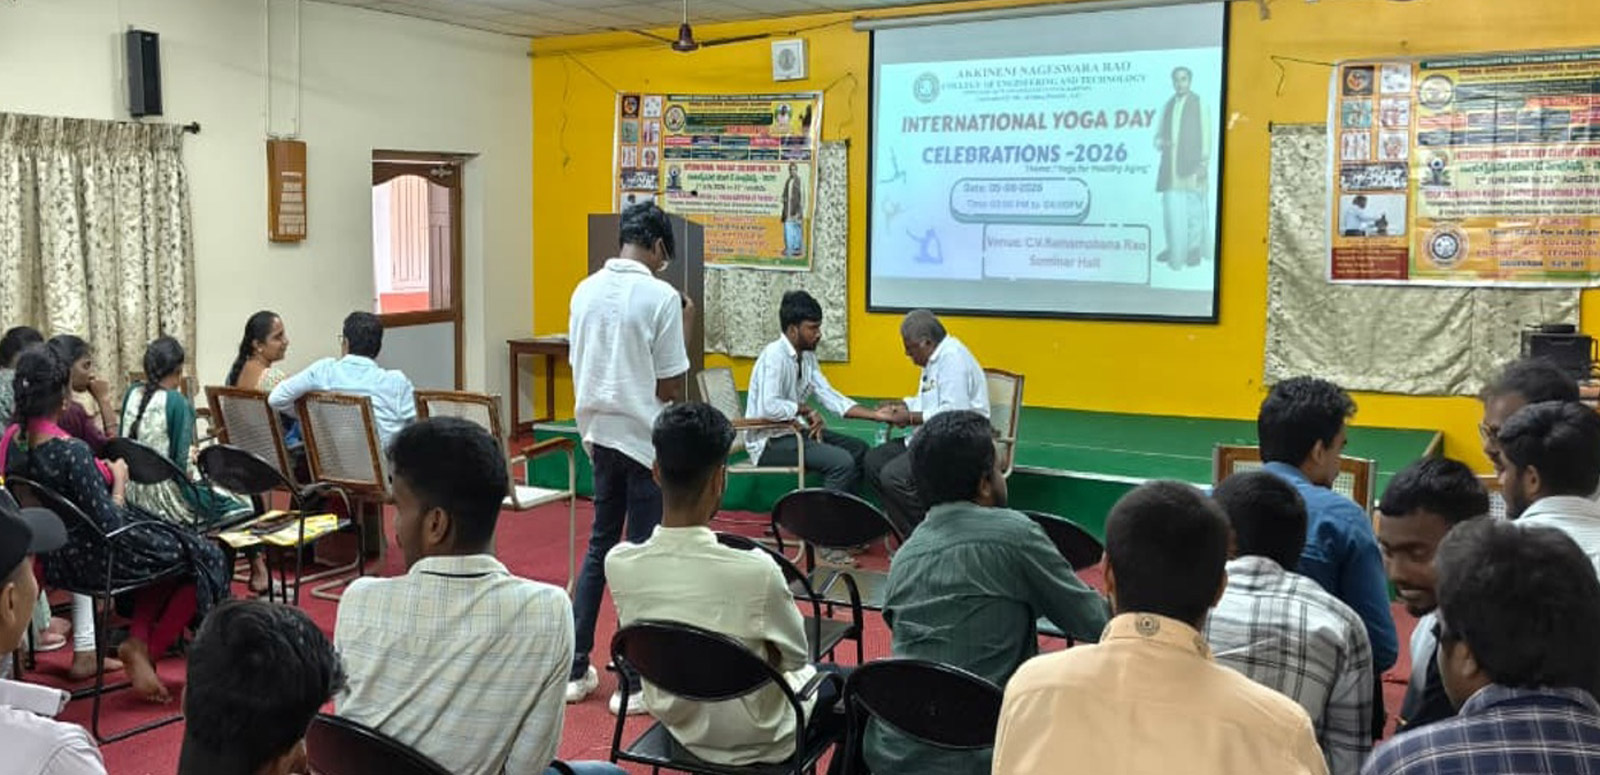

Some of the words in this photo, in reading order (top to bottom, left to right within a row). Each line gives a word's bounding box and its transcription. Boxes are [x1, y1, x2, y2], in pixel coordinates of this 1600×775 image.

[956, 68, 1016, 79] AKKINENI
[1019, 63, 1099, 76] NAGESWARA
[1102, 61, 1132, 72] RAO
[941, 81, 981, 91] COLLEGE
[984, 80, 994, 89] OF
[1060, 76, 1078, 86] AND
[1081, 74, 1146, 85] TECHNOLOGY
[901, 113, 1047, 133] INTERNATIONAL
[1052, 110, 1108, 129] YOGA
[1113, 108, 1157, 129] DAY
[922, 144, 1061, 165] CELEBRATIONS
[1065, 143, 1128, 163] -2026
[1015, 200, 1029, 209] PM
[1123, 239, 1147, 251] Rao
[1029, 255, 1075, 268] Seminar
[1078, 257, 1102, 269] Hall
